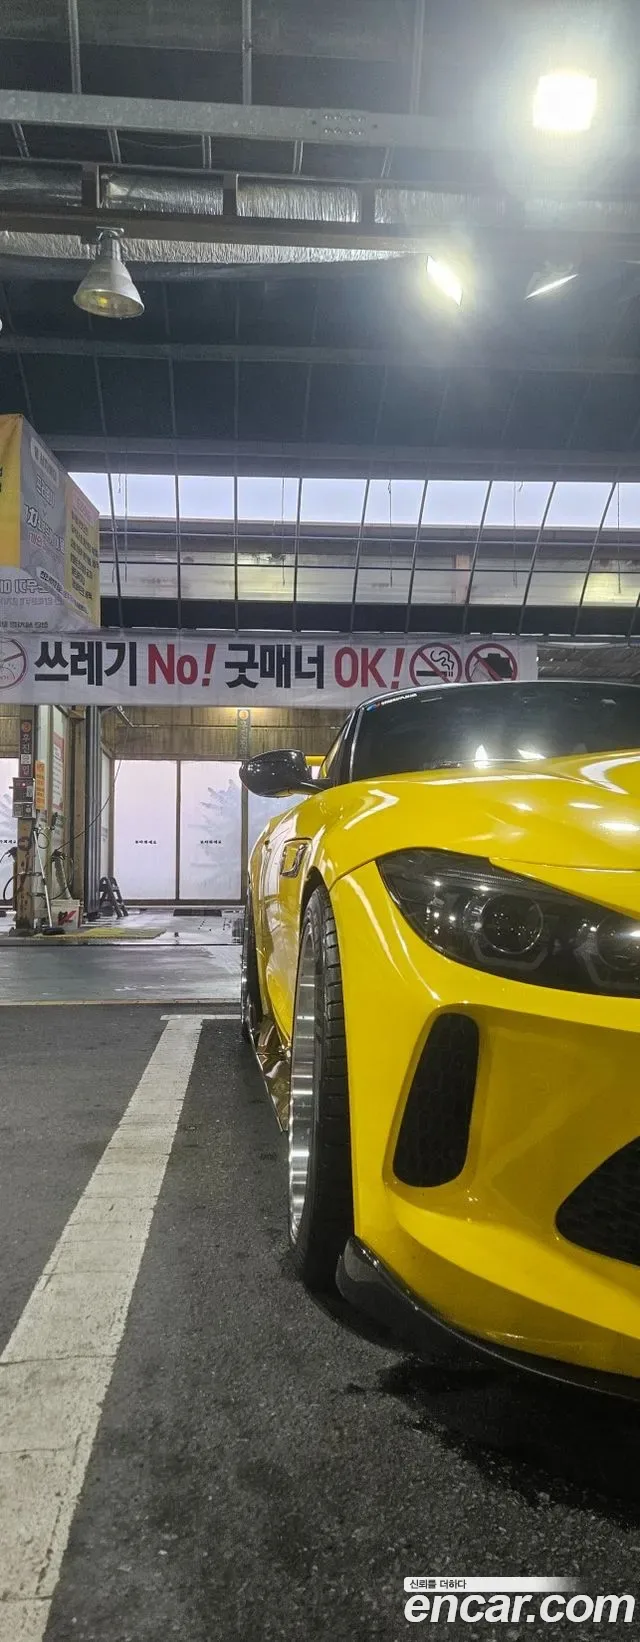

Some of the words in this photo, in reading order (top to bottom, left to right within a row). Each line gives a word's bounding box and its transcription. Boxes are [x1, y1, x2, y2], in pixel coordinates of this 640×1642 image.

[34, 641, 137, 687] 쓰레기
[148, 643, 217, 687] No!
[225, 643, 325, 689] 굿매너
[334, 645, 405, 690] OK!
